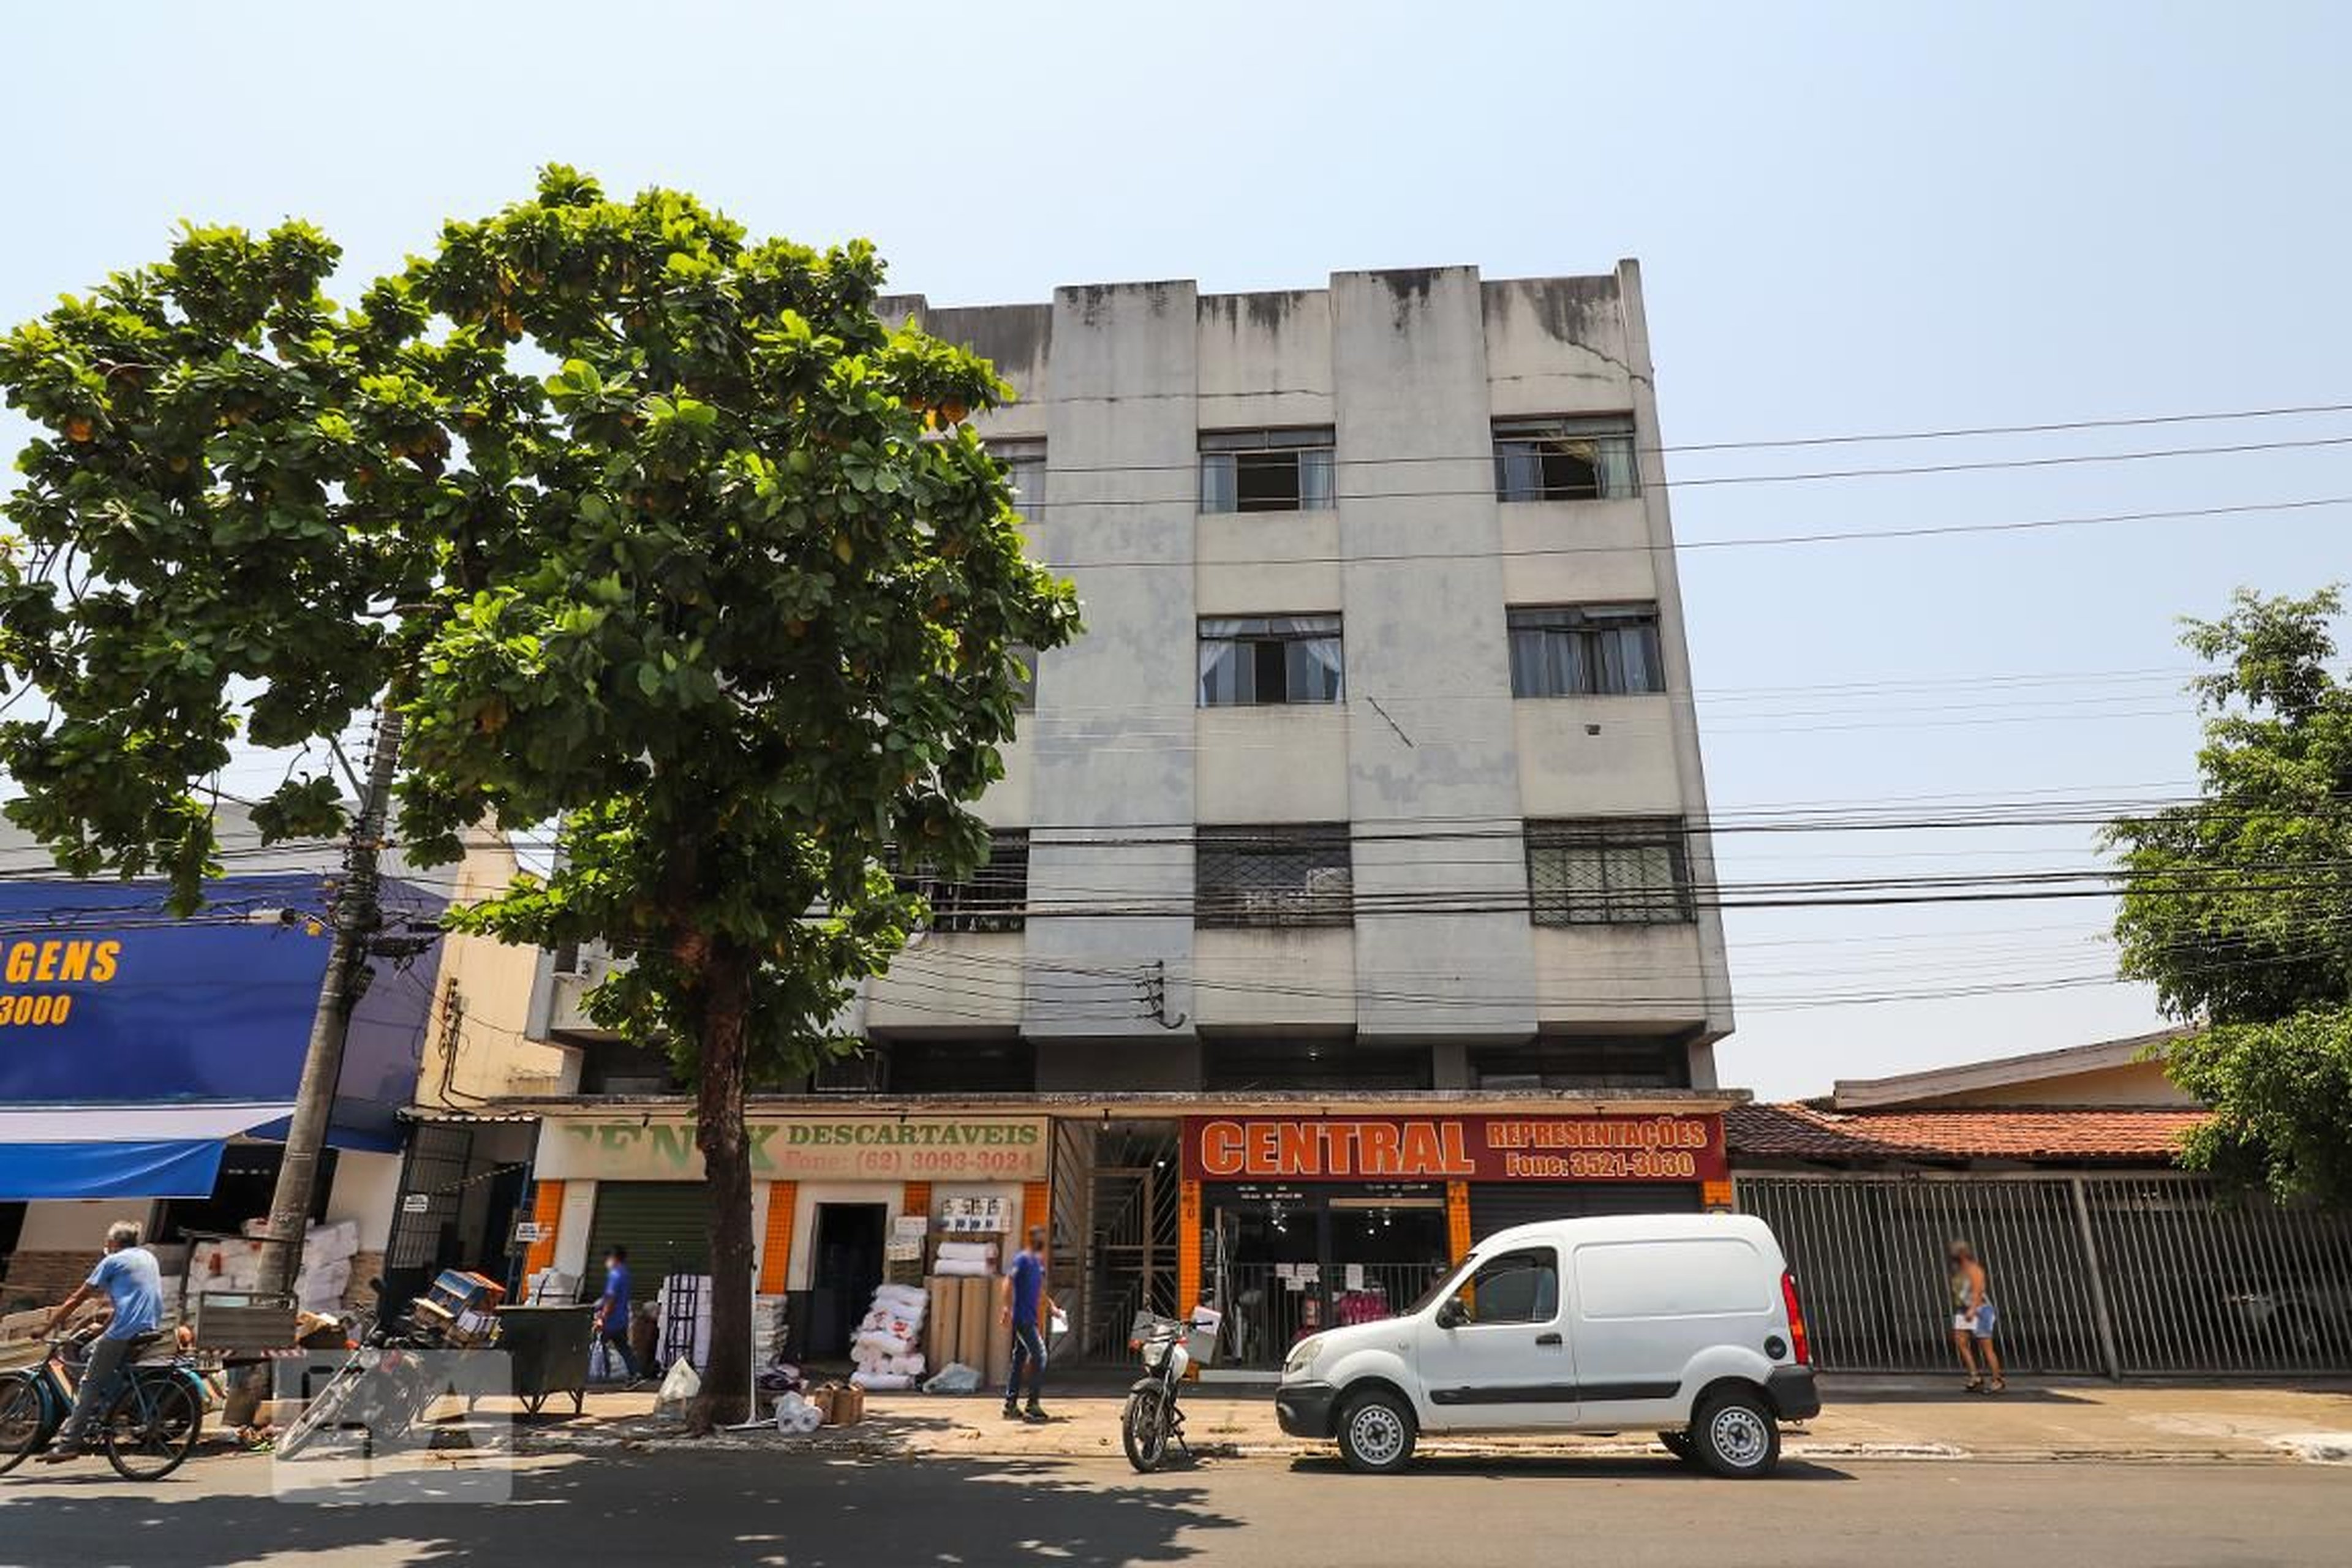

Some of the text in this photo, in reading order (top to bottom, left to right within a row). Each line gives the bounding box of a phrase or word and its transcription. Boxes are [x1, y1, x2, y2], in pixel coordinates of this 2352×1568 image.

[0, 940, 121, 983] GENS
[0, 995, 71, 1026] 3000
[788, 1121, 1038, 1145] DESCARTÁVEIS
[1202, 1121, 1475, 1175] CENTRAL
[1486, 1117, 1708, 1152] REPRESENTAÇÕES
[858, 1150, 902, 1172] (62)
[911, 1152, 1034, 1170] 3093-3024
